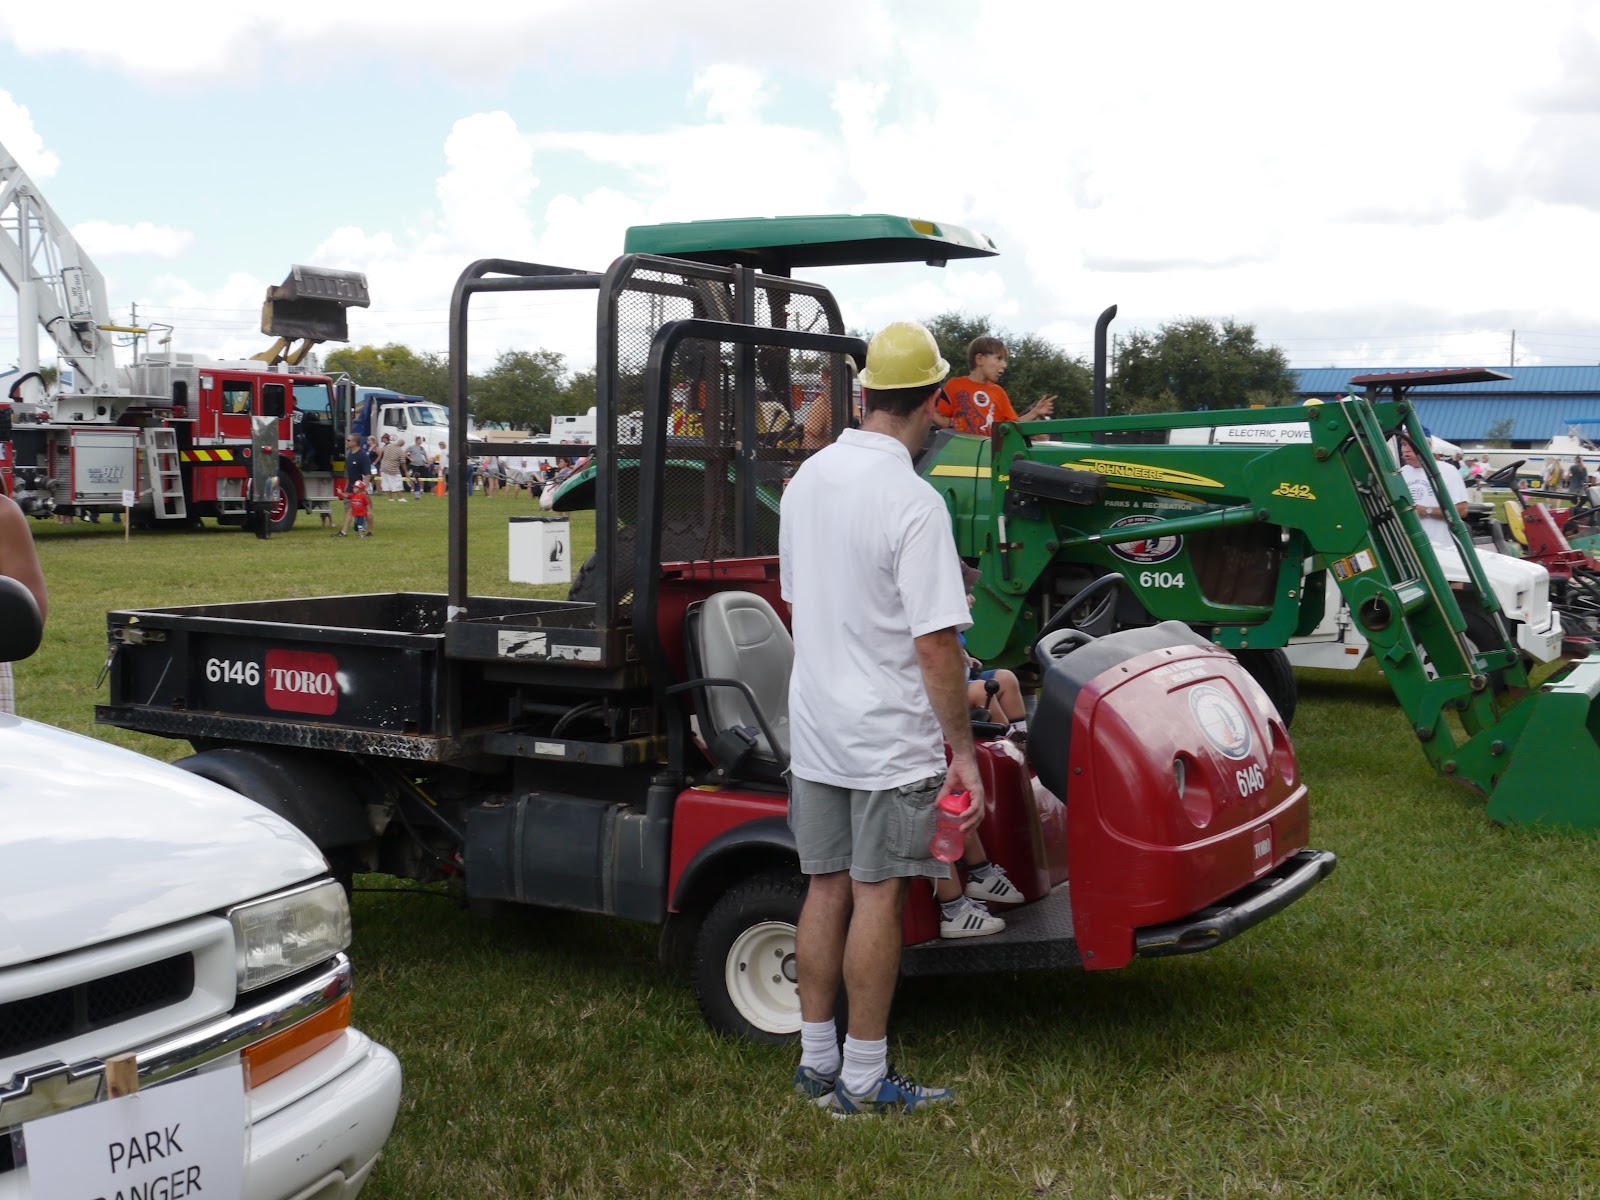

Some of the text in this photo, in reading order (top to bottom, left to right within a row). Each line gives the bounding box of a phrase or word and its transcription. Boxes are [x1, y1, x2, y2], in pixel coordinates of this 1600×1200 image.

[1228, 428, 1312, 439] ELECTRIC POWE
[102, 465, 124, 479] 911
[1089, 461, 1165, 480] JOHN DEERE
[1280, 482, 1311, 498] 542
[1104, 500, 1130, 508] PARKS
[1142, 501, 1193, 511] RECREATION
[1139, 571, 1185, 589] 6104
[205, 657, 261, 686] 6146
[1235, 763, 1265, 797] 6146
[109, 1123, 183, 1174] PARK
[92, 1165, 202, 1200] NGER
